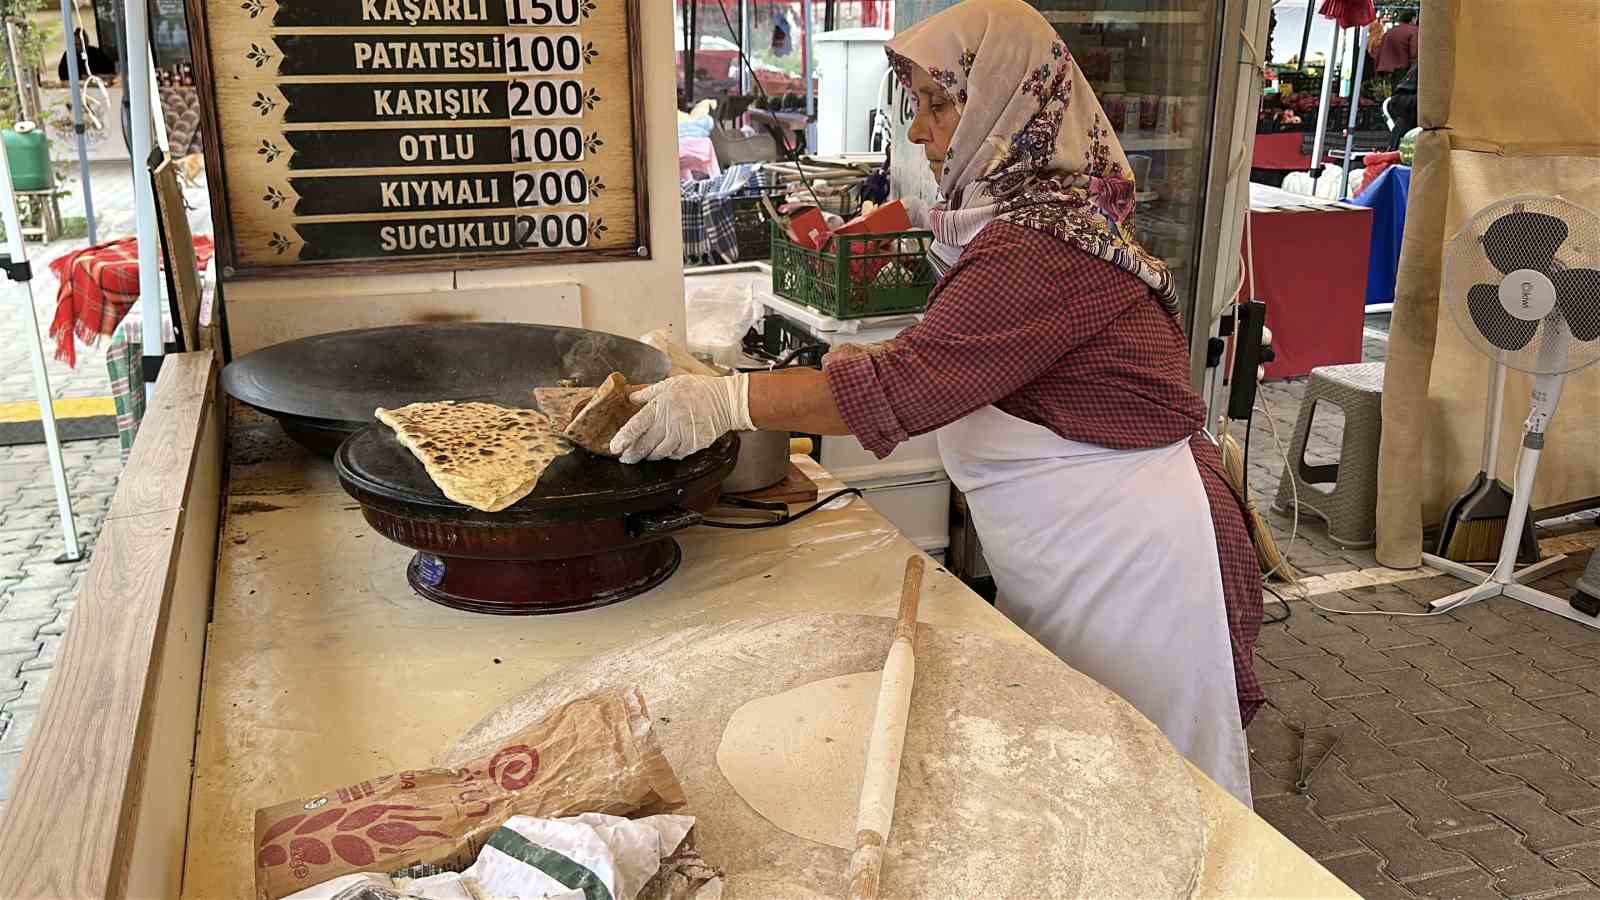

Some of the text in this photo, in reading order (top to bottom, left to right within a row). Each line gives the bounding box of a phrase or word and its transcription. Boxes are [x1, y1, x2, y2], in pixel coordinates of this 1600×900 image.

[362, 0, 581, 26] KAŞARLI 150
[354, 35, 581, 73] PATATESLİ 100
[374, 80, 583, 119] KARIŞIK 200
[399, 126, 583, 162] OTLU 100
[380, 169, 589, 207] KIYMALI 200
[379, 213, 589, 251] SUCUKLU 200
